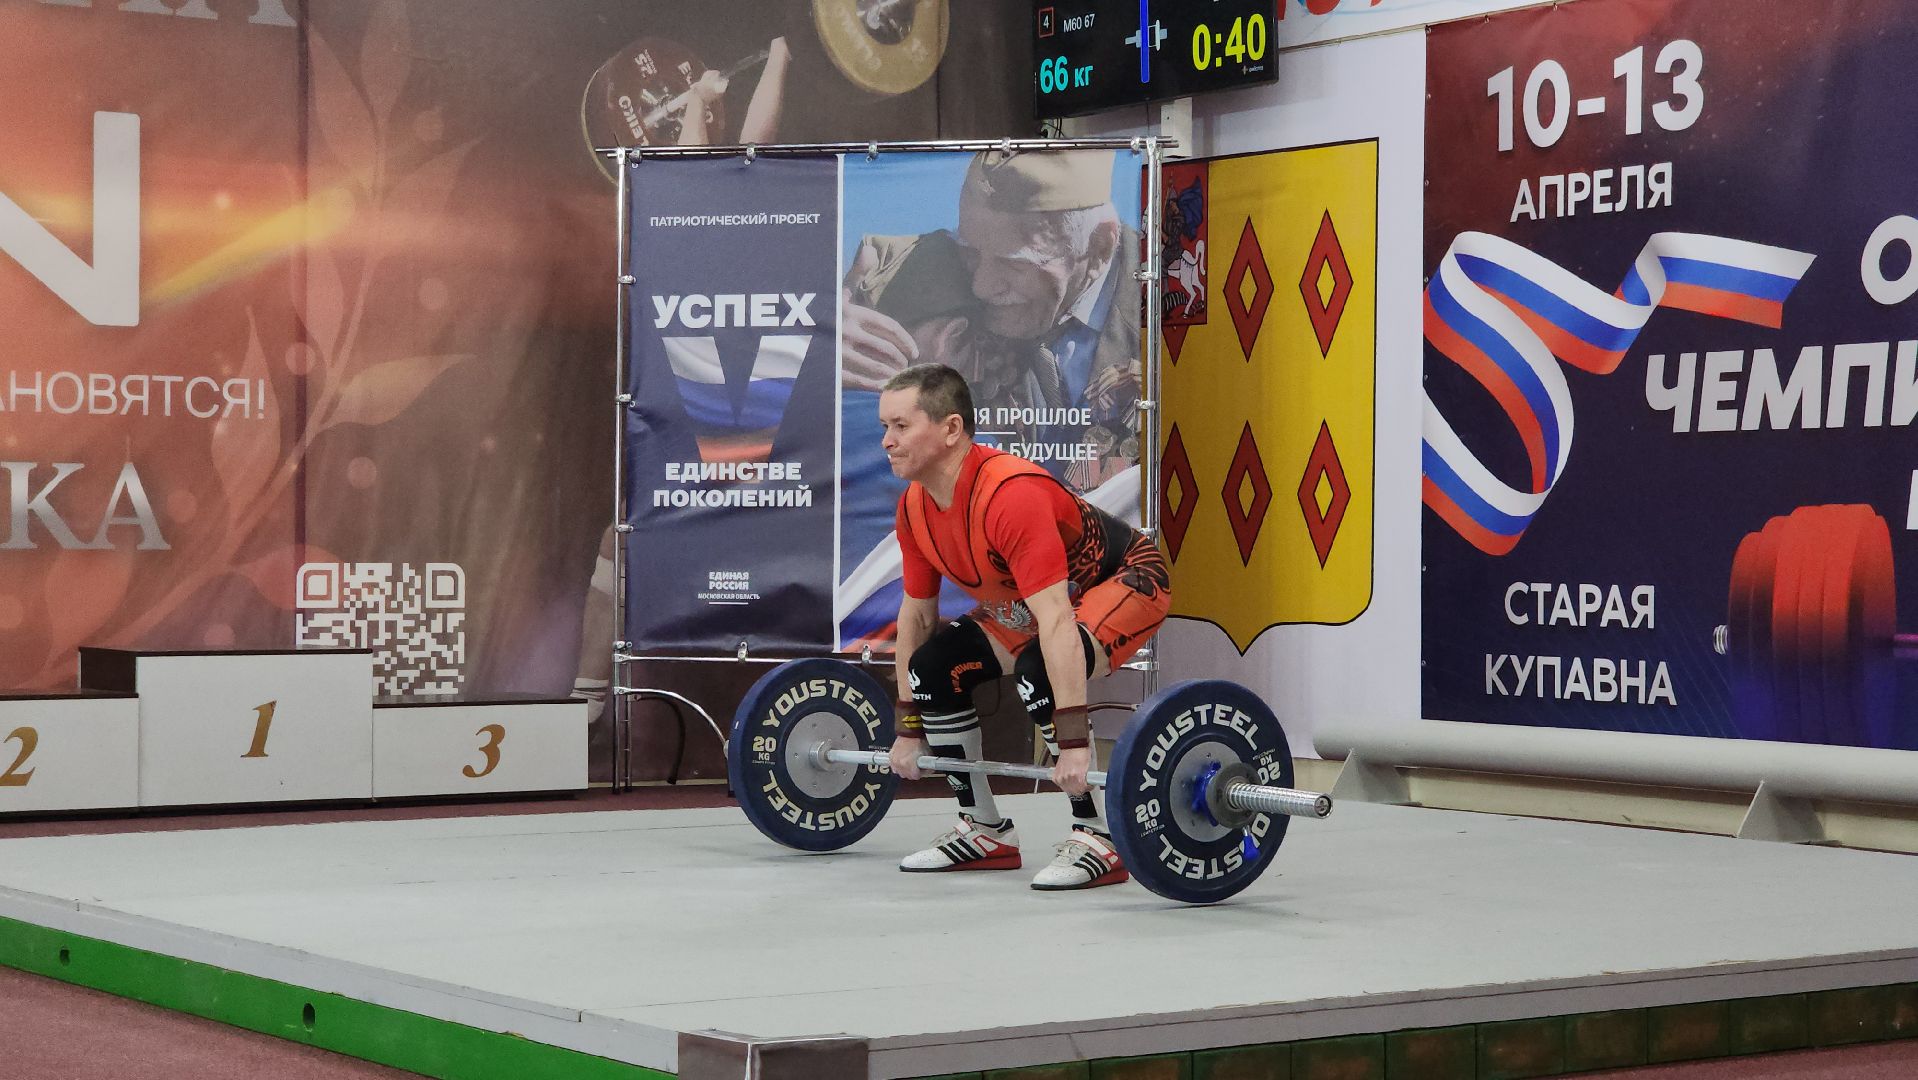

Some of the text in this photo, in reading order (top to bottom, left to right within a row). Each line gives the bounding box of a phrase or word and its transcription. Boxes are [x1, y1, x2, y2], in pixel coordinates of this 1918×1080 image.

[1043, 15, 1050, 29] 4
[1084, 13, 1096, 28] 67
[1192, 13, 1266, 71] 0:40
[1040, 56, 1094, 93] 66 кг
[1487, 39, 1704, 152] 10-13
[1510, 162, 1673, 223] АПРЕЛЯ
[650, 213, 821, 227] ПАТРИОТИЧЕСКИЙ ПРОЕКТ
[652, 292, 817, 329] УСПЕХ
[0, 370, 265, 419] НОВЯТСЯ!
[996, 407, 1092, 426] ПРОШЛОЕ
[1009, 443, 1098, 462] БУДУЩЕЕ
[665, 462, 802, 484] ЕДИНСТВЕ
[653, 485, 812, 507] ПОКОЛЕНИЙ
[709, 571, 749, 581] ЕДИНАЯ
[709, 581, 749, 590] РОССИЯ
[1504, 581, 1656, 630] СТАРАЯ
[1485, 653, 1678, 706] КУПАВНА
[762, 679, 881, 741] YOUSTEEL
[241, 700, 277, 758] 1
[752, 735, 777, 752] 20
[0, 727, 39, 786] 2
[462, 723, 506, 778] 3
[758, 752, 770, 761] KG
[1138, 703, 1260, 792] YOUSTEEL
[1257, 761, 1281, 785] 20
[762, 769, 882, 832] YOUSTEEL
[1135, 798, 1160, 824] 20
[1144, 818, 1158, 831] KG
